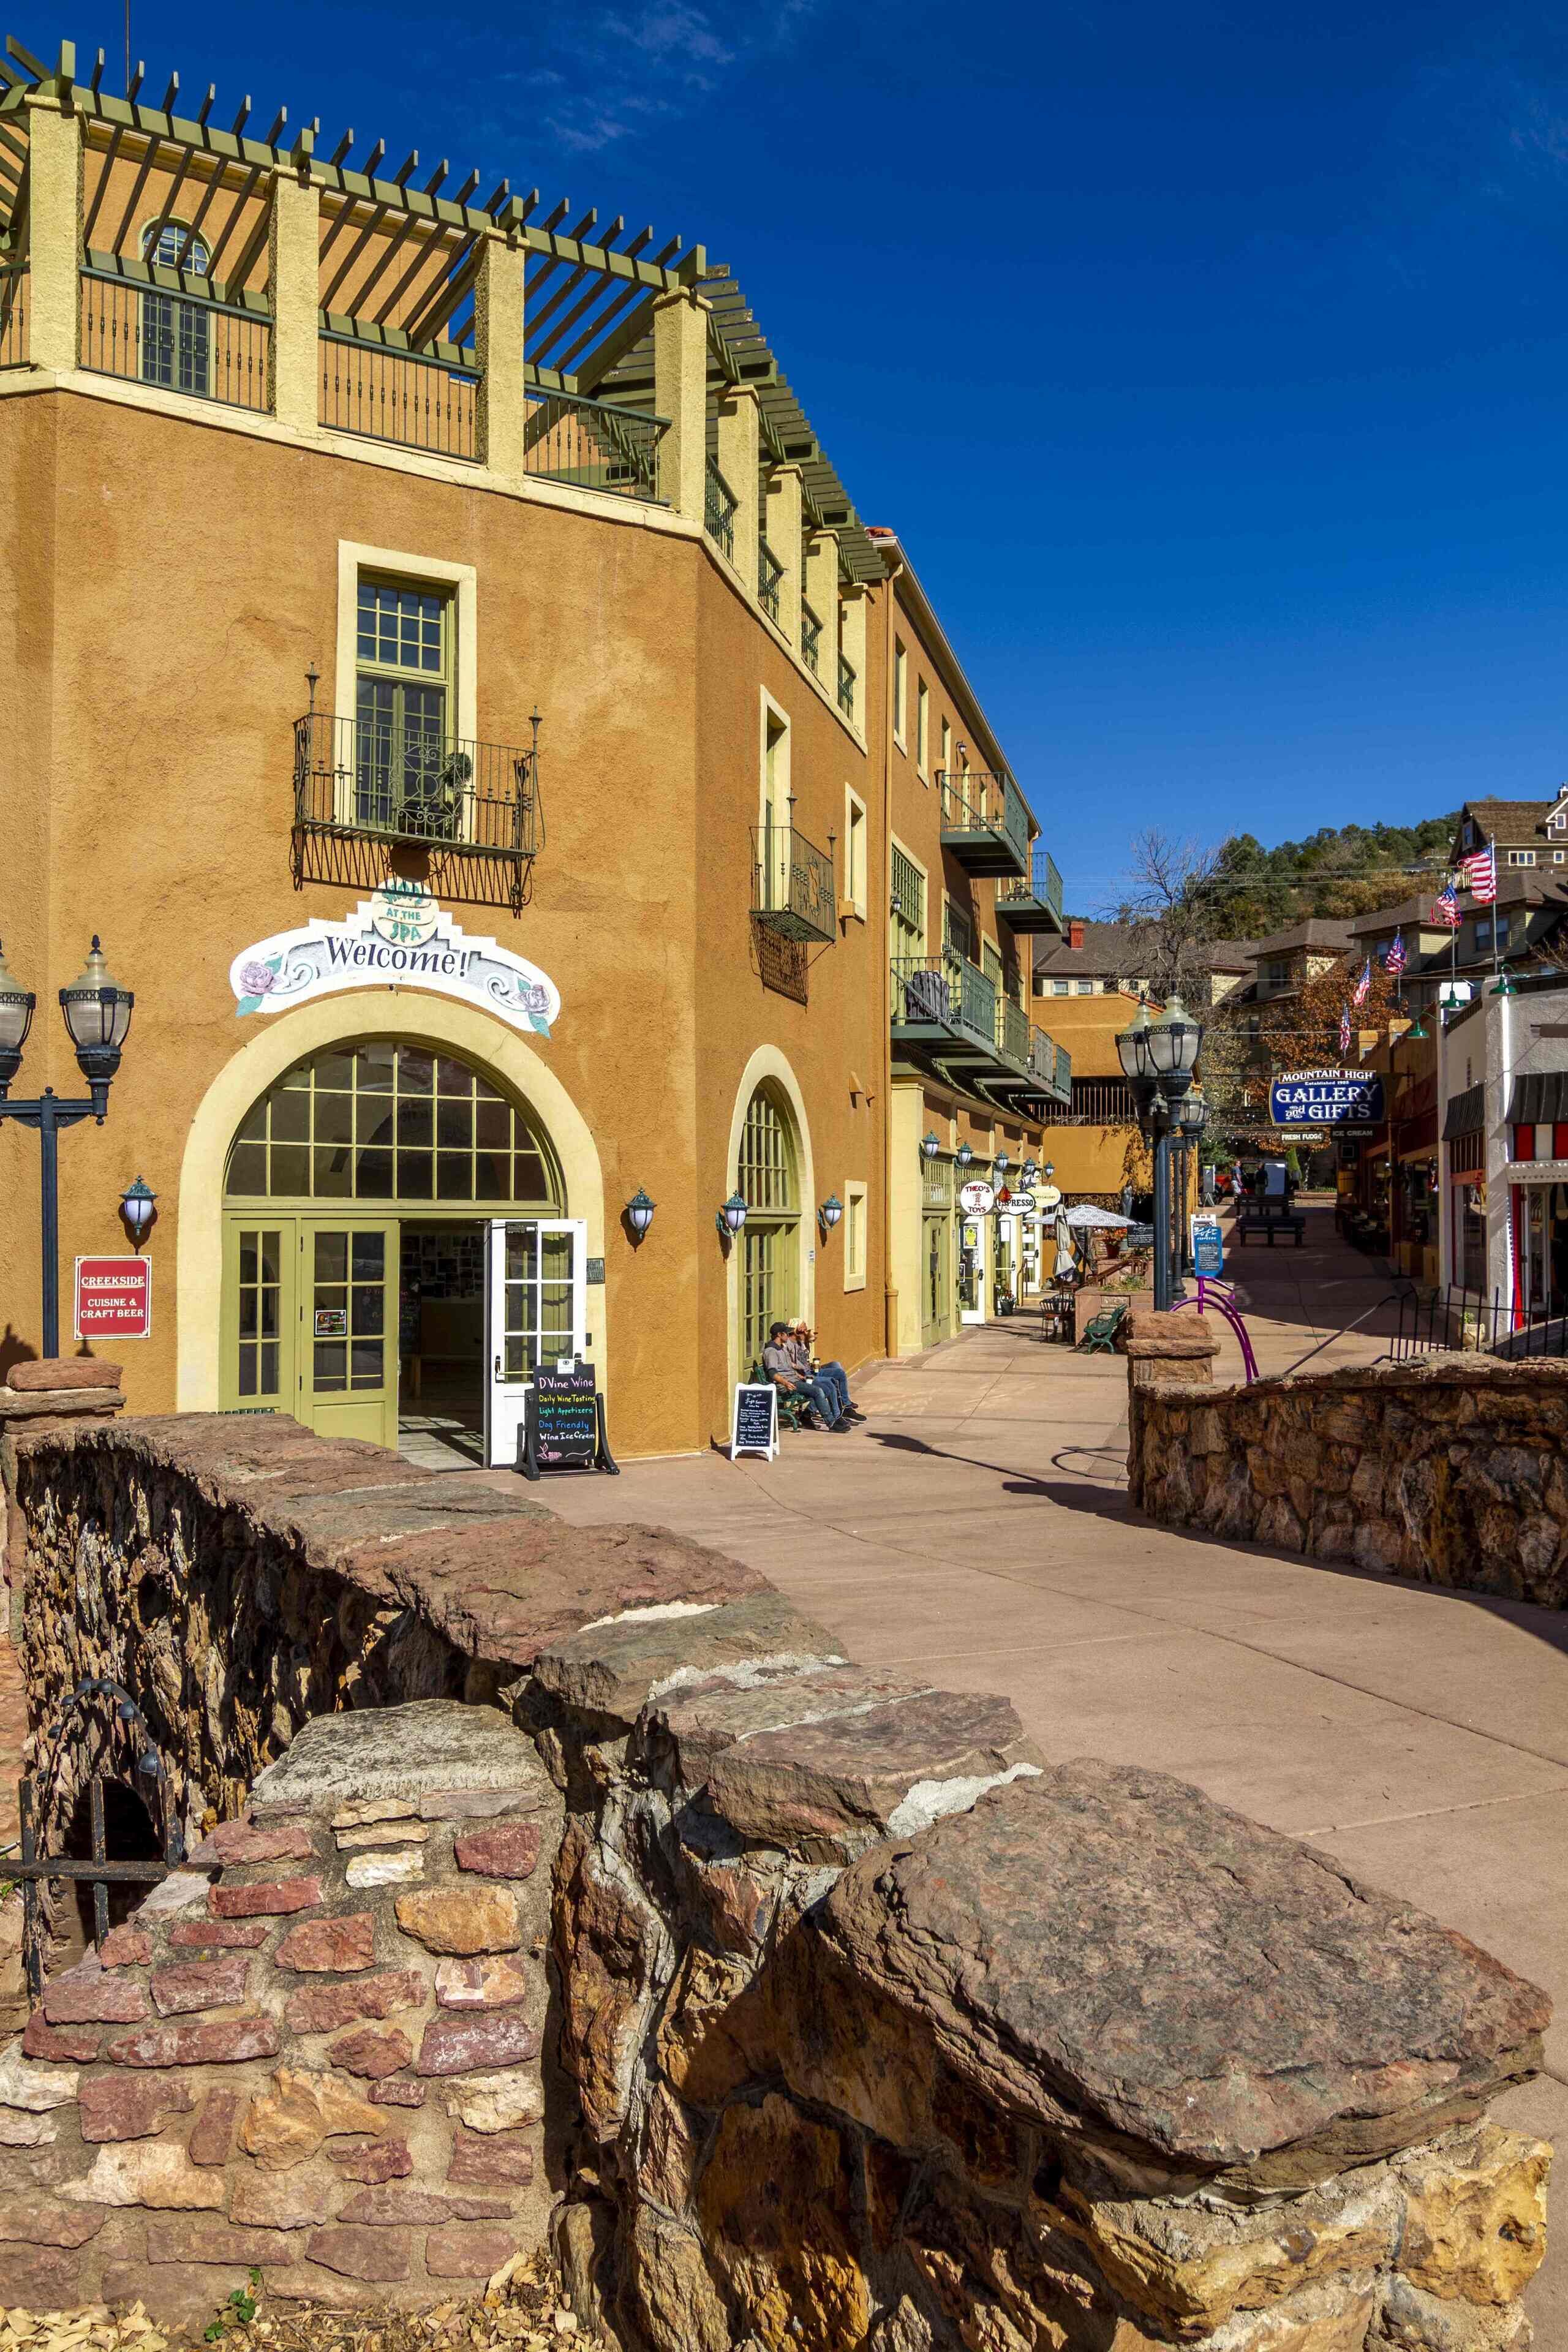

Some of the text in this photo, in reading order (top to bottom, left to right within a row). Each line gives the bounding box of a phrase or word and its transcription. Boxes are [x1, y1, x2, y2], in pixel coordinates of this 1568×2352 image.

[386, 907, 421, 920] AT THE
[390, 922, 421, 943] SPA
[325, 935, 467, 977] Welcome!
[1282, 1069, 1373, 1082] MOUNTAIN HIGH
[1275, 1084, 1379, 1103] GALLERY
[1286, 1104, 1371, 1120] and GIFTS
[81, 1276, 145, 1286] CREEKSIDE
[88, 1298, 127, 1307] CUISINE
[80, 1309, 144, 1318] CRAFT BEER
[571, 1376, 594, 1387] Wine
[539, 1395, 556, 1404] Daily
[539, 1406, 594, 1417] Light Appetizers
[539, 1420, 589, 1431] Dog Friendly
[574, 1431, 595, 1439] Cream
